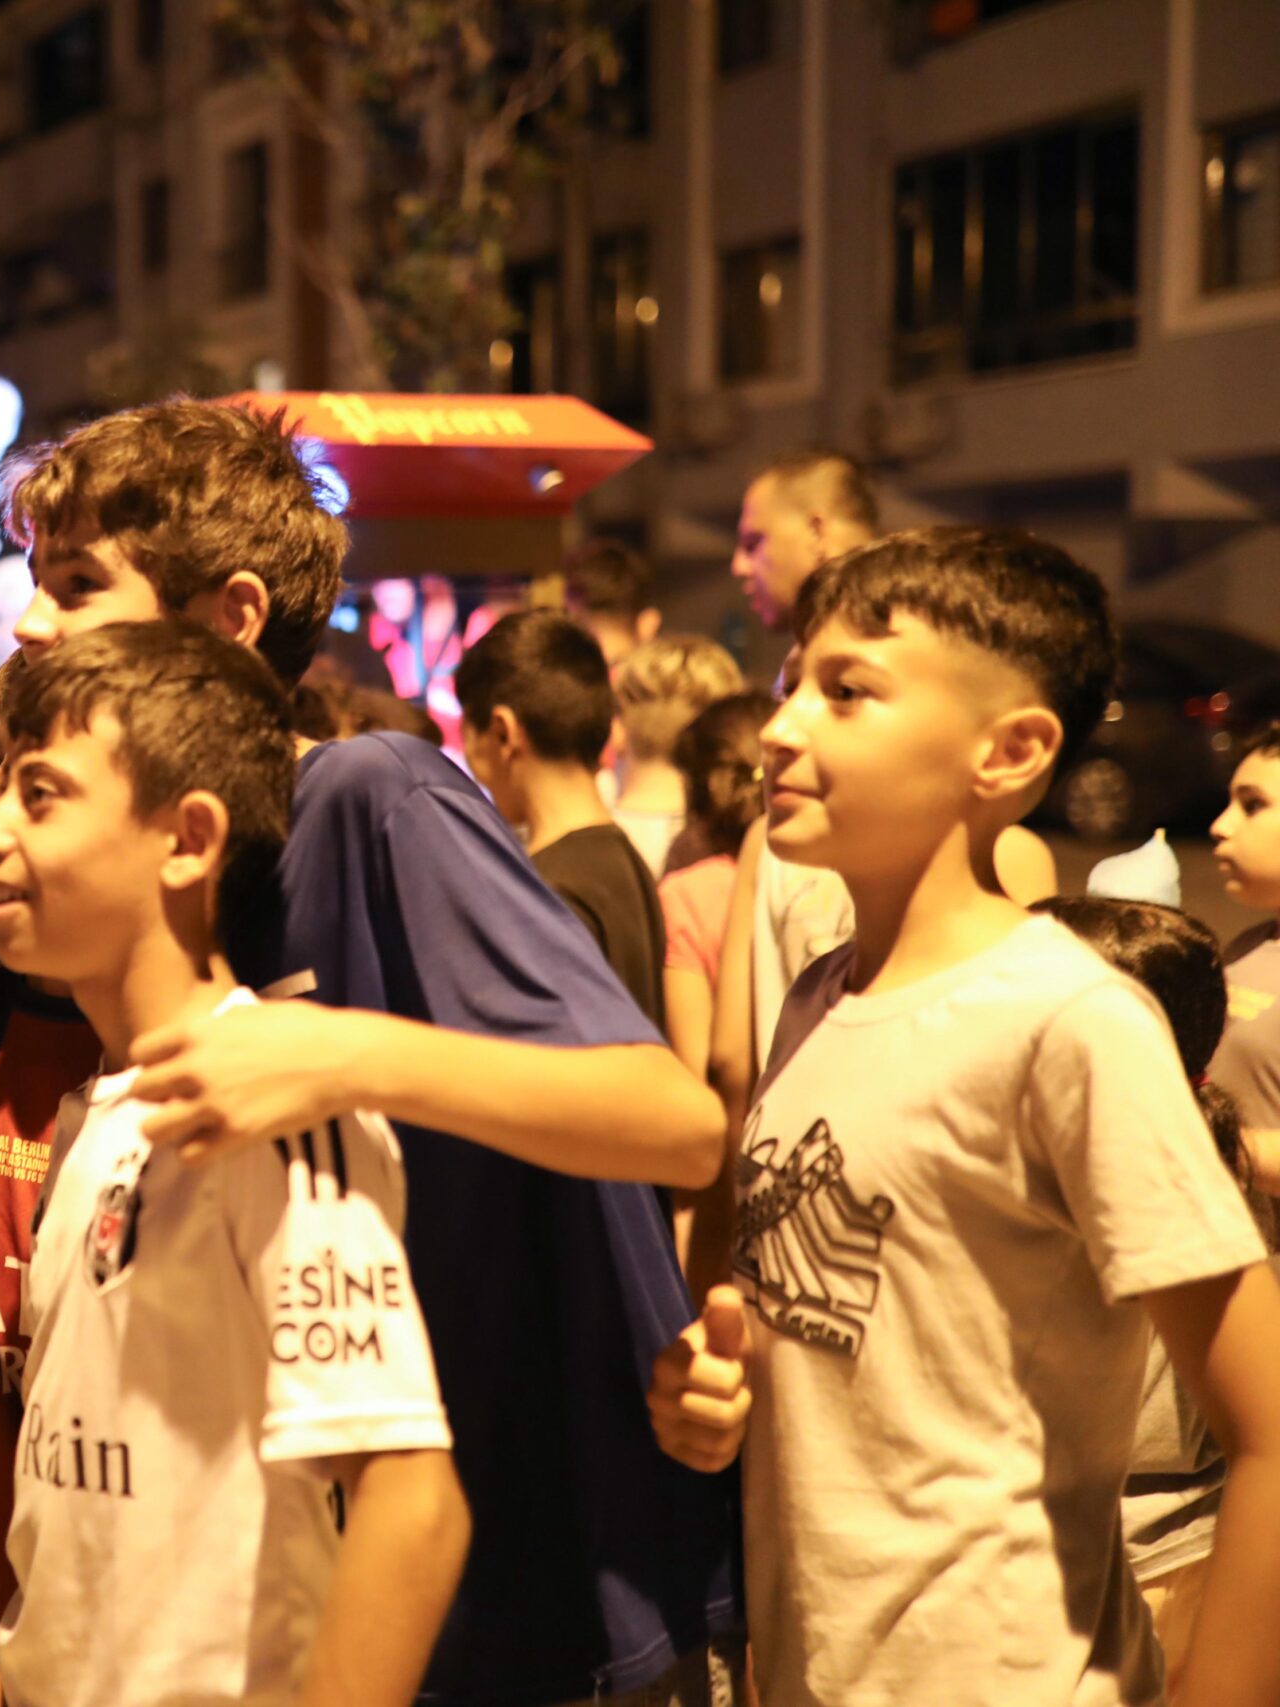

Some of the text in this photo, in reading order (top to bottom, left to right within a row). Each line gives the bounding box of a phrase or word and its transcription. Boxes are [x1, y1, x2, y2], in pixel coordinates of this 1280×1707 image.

[12, 1136, 51, 1160] BERLIN
[272, 1320, 384, 1364] COM
[23, 1402, 134, 1499] Rain
